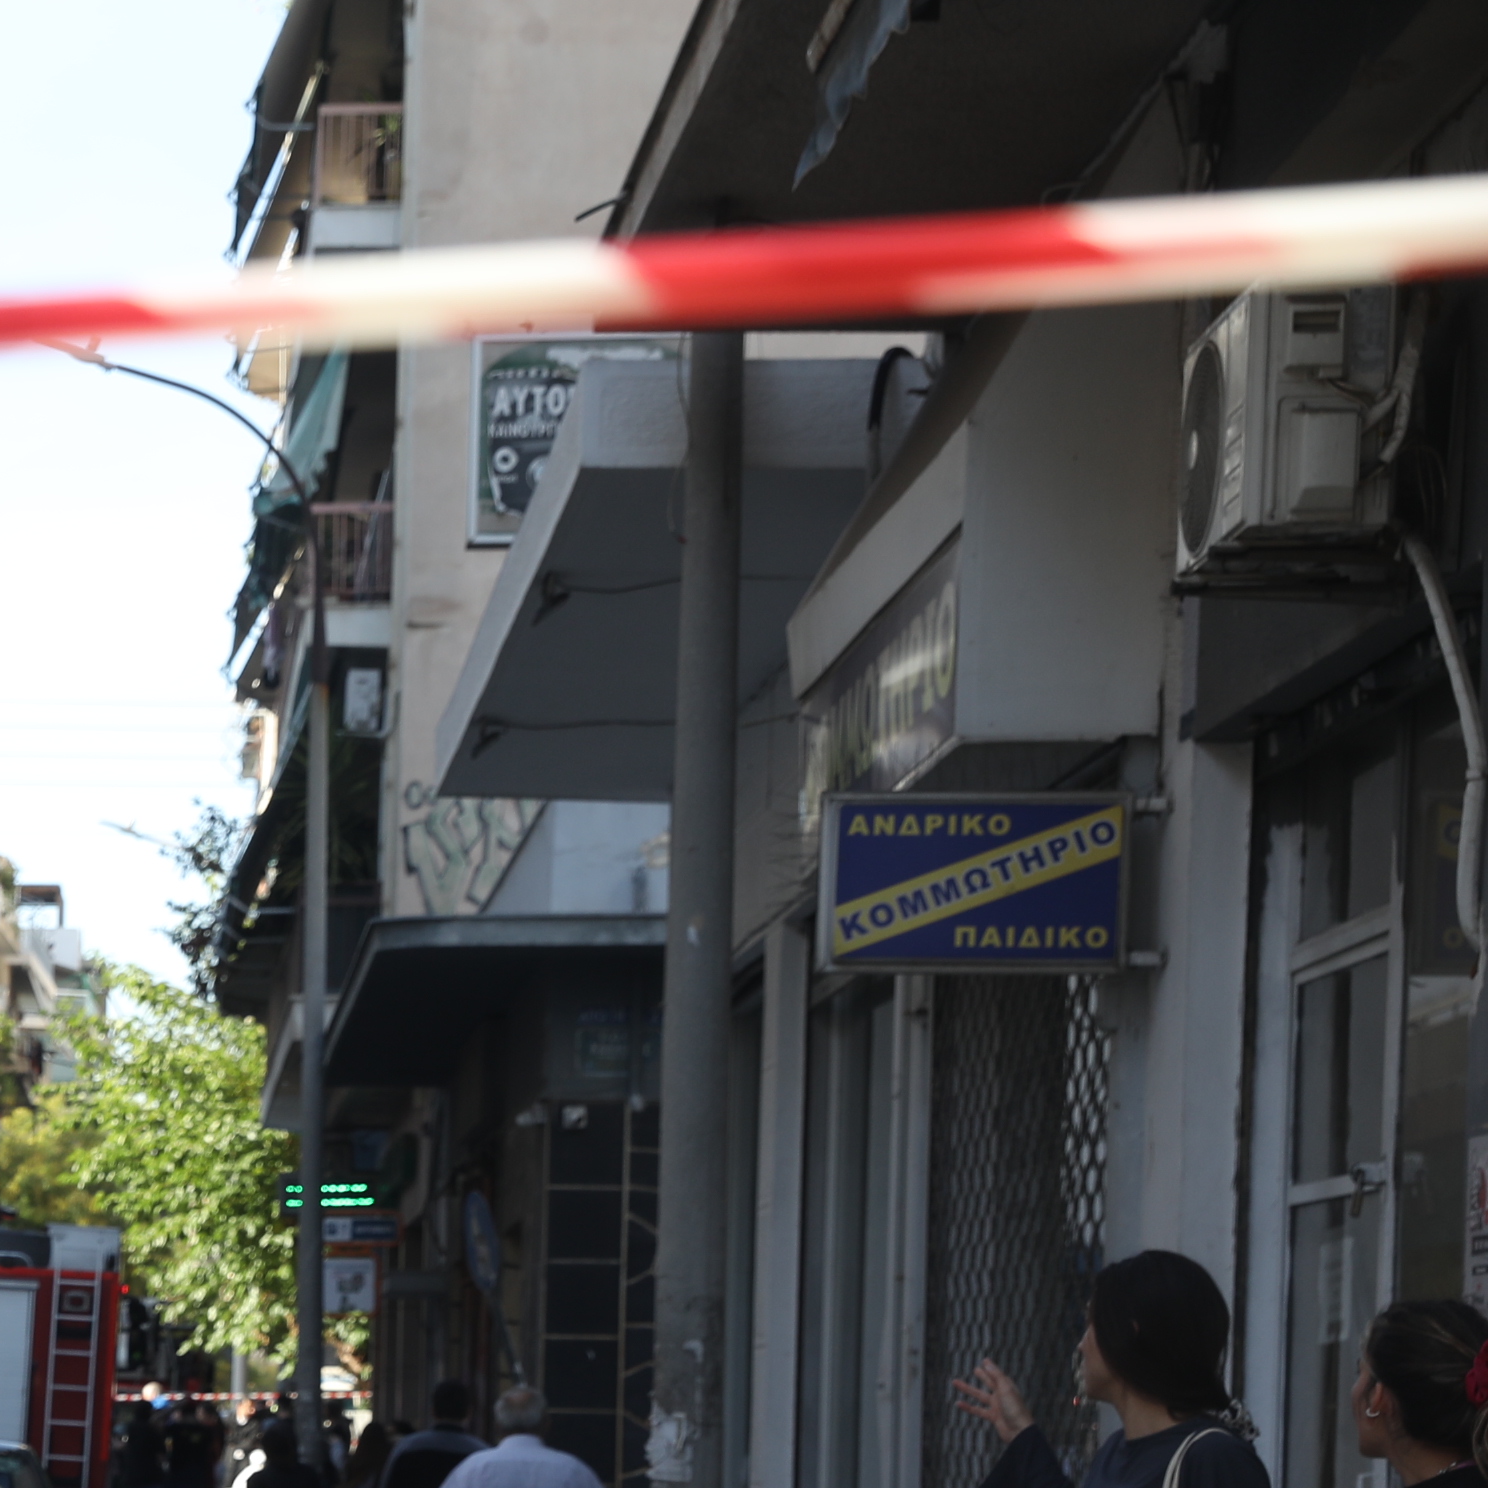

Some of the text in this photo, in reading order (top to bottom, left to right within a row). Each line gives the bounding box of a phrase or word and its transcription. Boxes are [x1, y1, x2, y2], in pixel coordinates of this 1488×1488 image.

[847, 813, 1012, 837] ΑΝΔΡΙΚΟ
[837, 820, 1118, 942] ΚΟΜΜΩΤΗΡΙΟ
[953, 925, 1110, 949] ΠΑΙΔΙΚΟ
